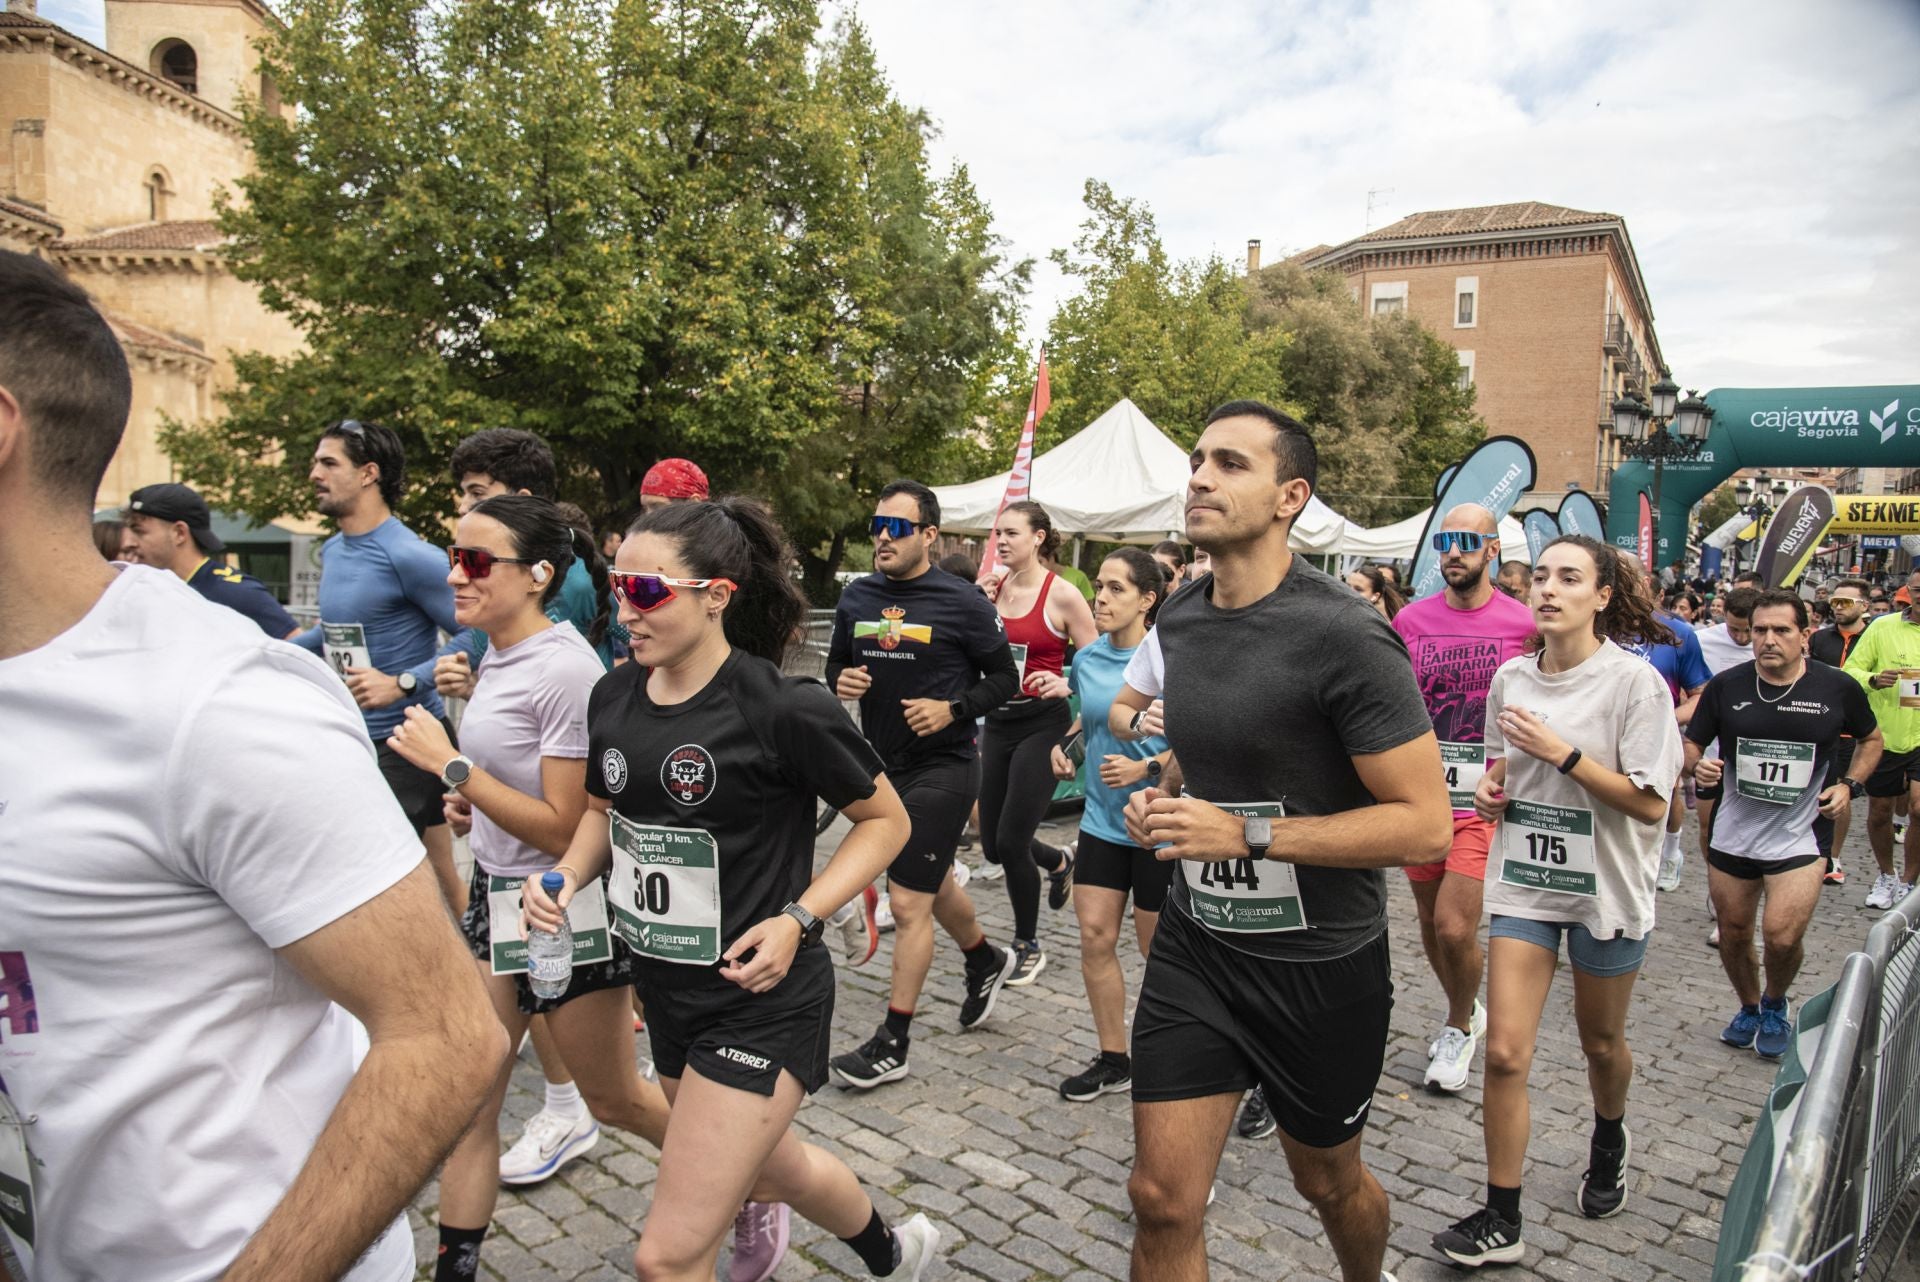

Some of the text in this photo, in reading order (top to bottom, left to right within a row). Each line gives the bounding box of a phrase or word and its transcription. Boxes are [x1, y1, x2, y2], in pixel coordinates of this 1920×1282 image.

[1750, 406, 1859, 432] cajaviva
[1798, 426, 1858, 439] Segovia
[1863, 537, 1897, 547] META
[862, 649, 916, 660] MARTIN MIGUEL
[1421, 643, 1498, 667] CARRERA
[1422, 642, 1437, 655] 15
[1446, 679, 1490, 693] AMIGO
[1777, 705, 1820, 714] Healthineers
[1791, 700, 1821, 709] SIEMENS
[1758, 762, 1789, 783] 171
[1515, 802, 1536, 812] Carrera
[1536, 807, 1558, 816] popular
[1565, 810, 1578, 818] km.
[1520, 819, 1541, 828] CONTRA
[665, 832, 672, 842] 9
[674, 833, 693, 844] km.
[1525, 832, 1567, 865] 175
[649, 854, 684, 865] CÁNCER
[1200, 858, 1260, 891] 244
[633, 866, 670, 916] 30
[1235, 905, 1284, 920] cajarural
[651, 933, 700, 947] cajarural
[727, 1047, 772, 1070] TERREX
